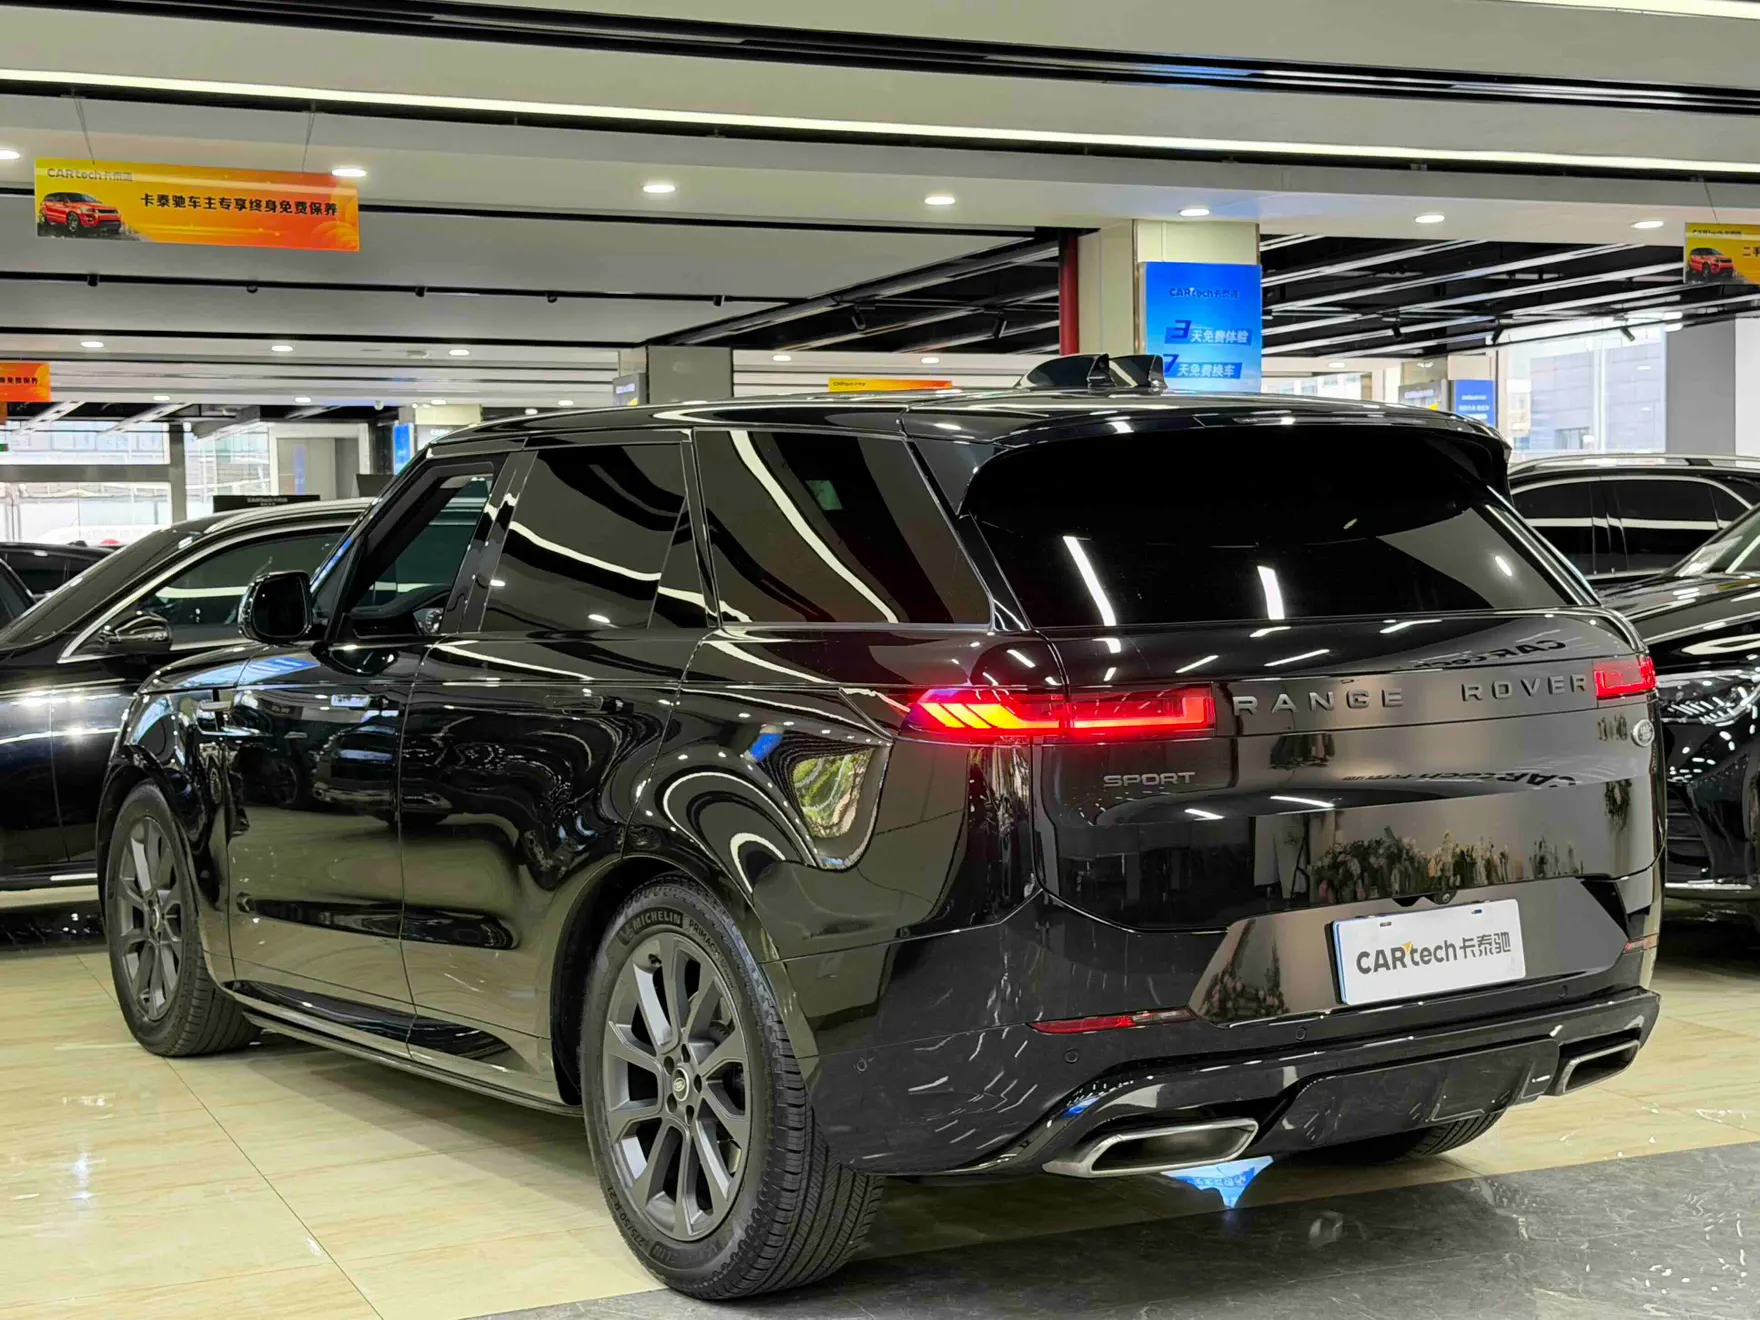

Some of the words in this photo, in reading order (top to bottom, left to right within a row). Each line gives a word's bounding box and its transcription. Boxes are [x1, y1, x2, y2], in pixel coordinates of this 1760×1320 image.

[140, 192, 338, 216] 卡泰驰车主专享终身免费保养
[1232, 688, 1404, 716] RANGE
[1461, 674, 1588, 702] ROVER
[1103, 771, 1196, 788] SPORT
[632, 910, 681, 930] MICHELIN
